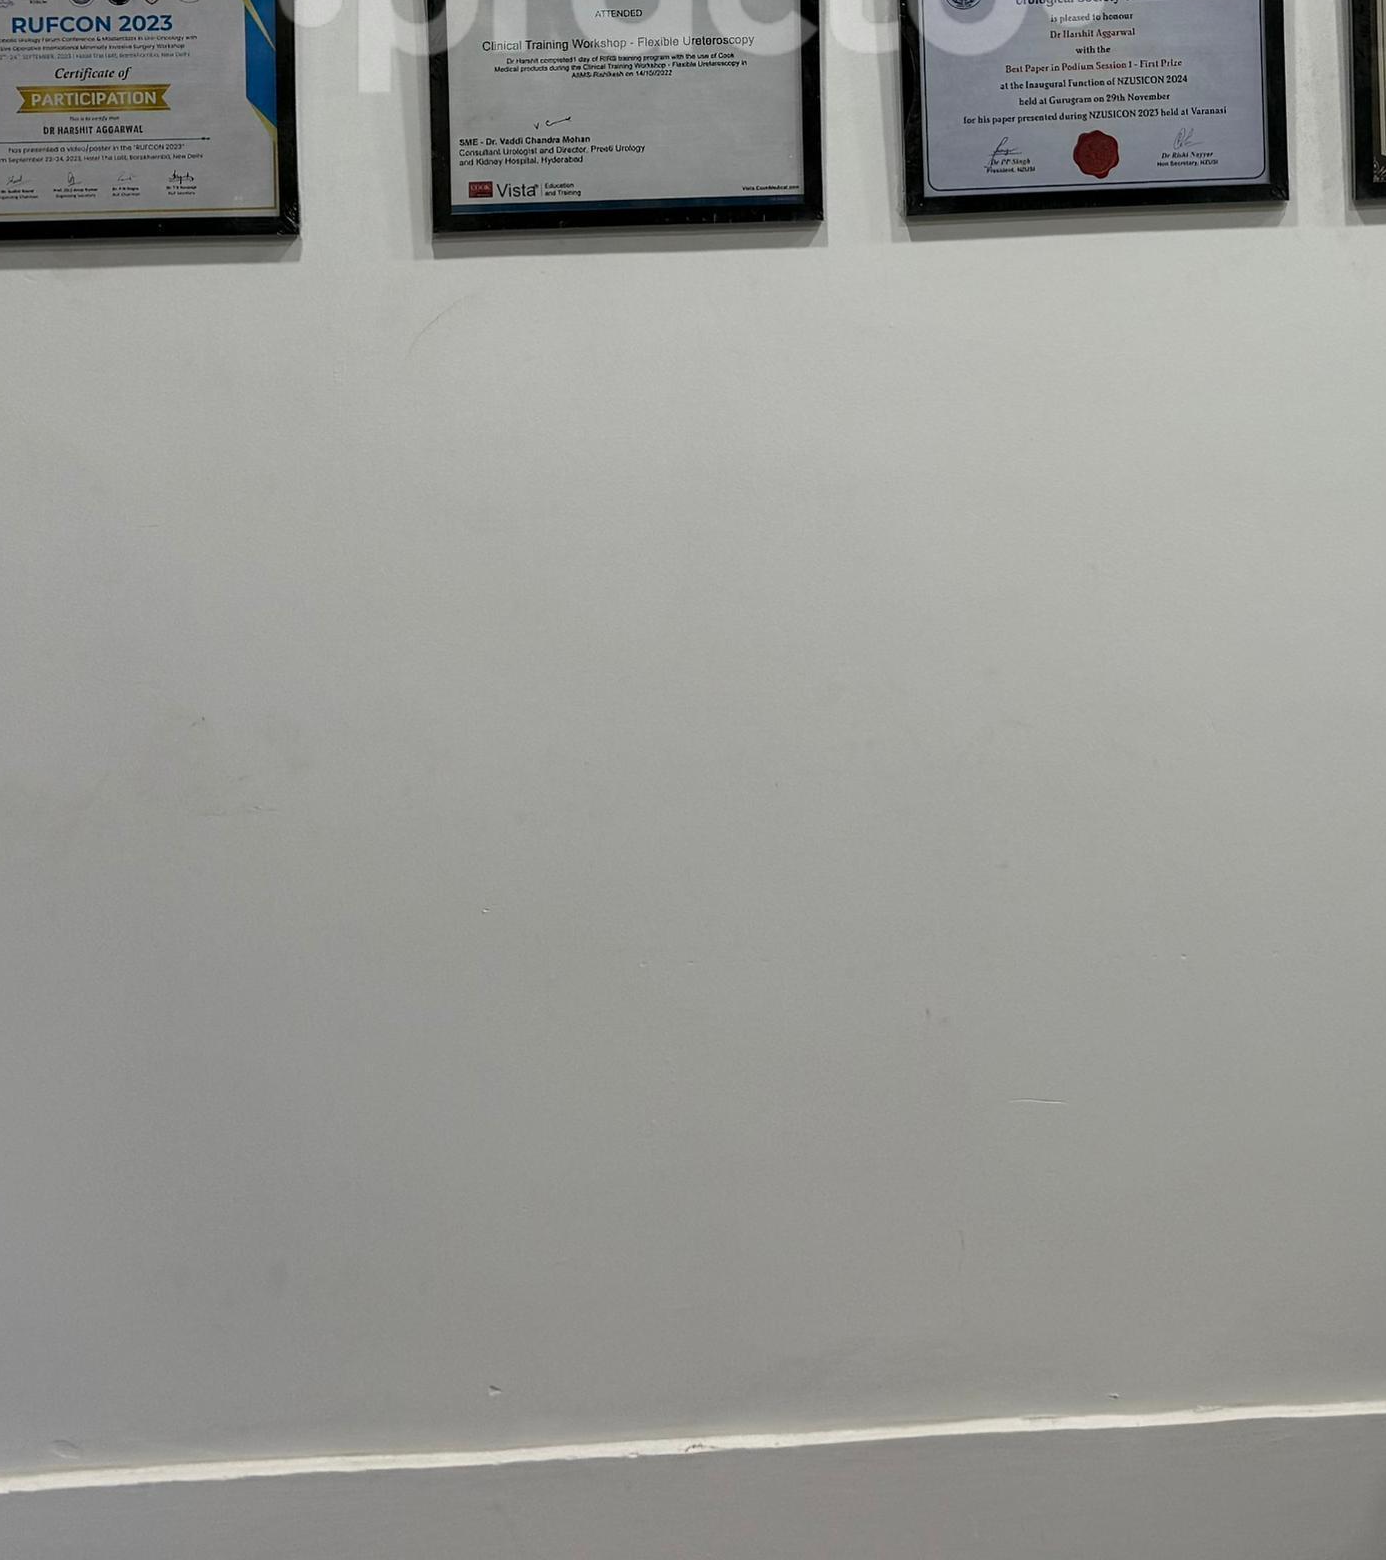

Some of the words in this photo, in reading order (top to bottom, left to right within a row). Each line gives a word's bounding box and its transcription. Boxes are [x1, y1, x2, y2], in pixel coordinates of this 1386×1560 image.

[595, 9, 643, 18] ATTENDED
[12, 16, 111, 33] RUFCON
[118, 15, 172, 32] 2023
[1050, 30, 1061, 39] Dr
[1063, 29, 1094, 38] Harshit
[1096, 27, 1135, 39] Aggarwal
[482, 41, 522, 52] Clinical
[525, 40, 569, 52] Training
[571, 38, 626, 49] Workshop
[637, 36, 679, 47] Flexible
[683, 35, 754, 48] Ureteroscopy
[54, 67, 115, 81] Certificate
[118, 66, 132, 81] of
[1000, 82, 1009, 90] at
[1010, 81, 1024, 90] the
[1025, 79, 1066, 90] Inaugural
[1068, 78, 1105, 87] Function
[1106, 77, 1115, 86] of
[1117, 75, 1164, 85] NZUSICON
[1166, 75, 1188, 83] 2024
[32, 92, 156, 106] PARTICIPATION
[43, 126, 55, 135] DR
[57, 126, 93, 135] HARSHIT
[96, 125, 143, 134] AGGARWAL
[496, 183, 539, 198] Vista
